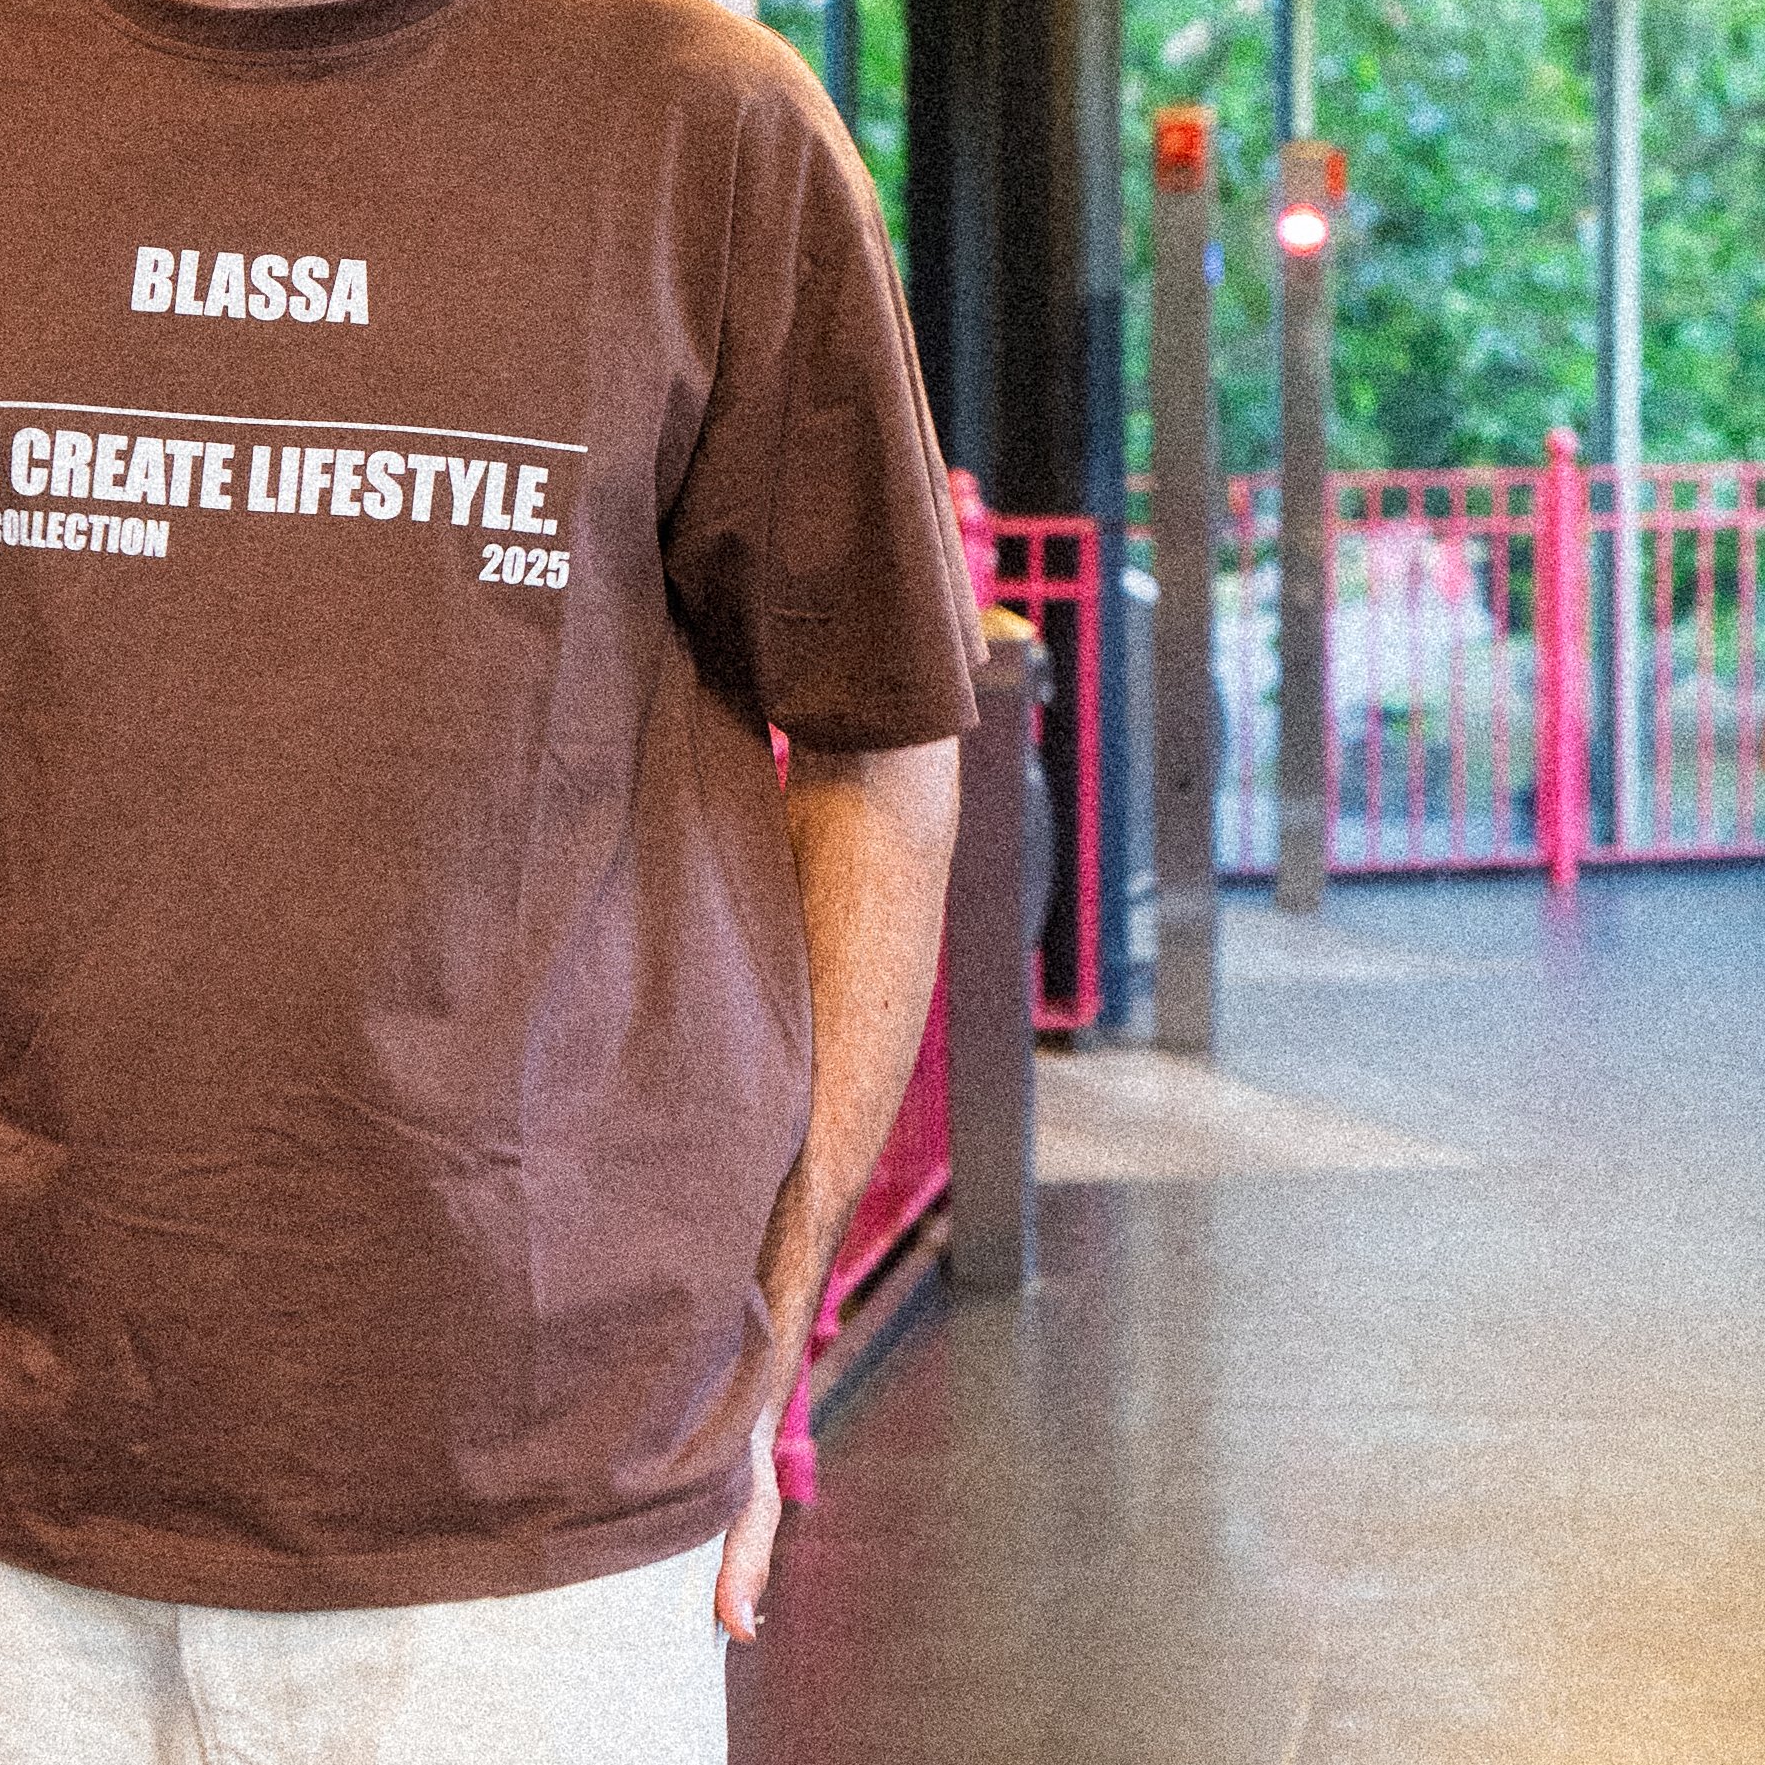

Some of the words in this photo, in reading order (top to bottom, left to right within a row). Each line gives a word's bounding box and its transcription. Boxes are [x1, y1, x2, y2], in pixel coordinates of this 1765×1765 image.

[130, 245, 370, 326] BLASSA
[10, 427, 236, 511] CREATE
[246, 444, 558, 536] LIFESTYLE.
[478, 543, 571, 590] 2025
